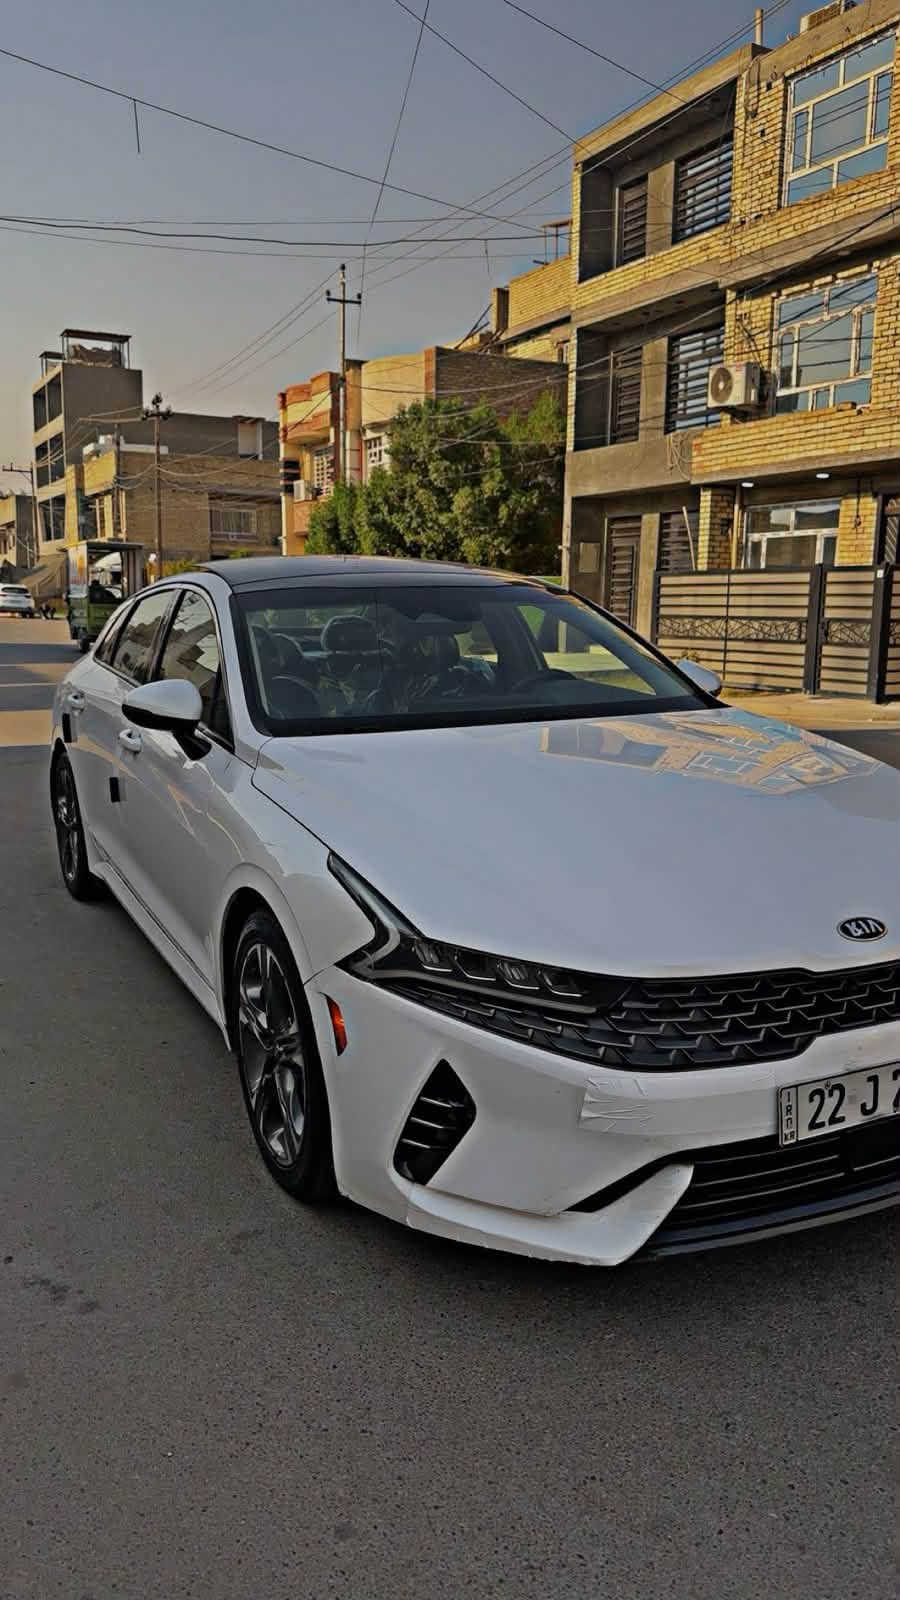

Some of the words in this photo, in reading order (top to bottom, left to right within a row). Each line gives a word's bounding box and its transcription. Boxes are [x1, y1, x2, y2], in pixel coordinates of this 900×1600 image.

[844, 920, 884, 937] KIA
[808, 1083, 846, 1131] 22
[860, 1074, 879, 1116] J
